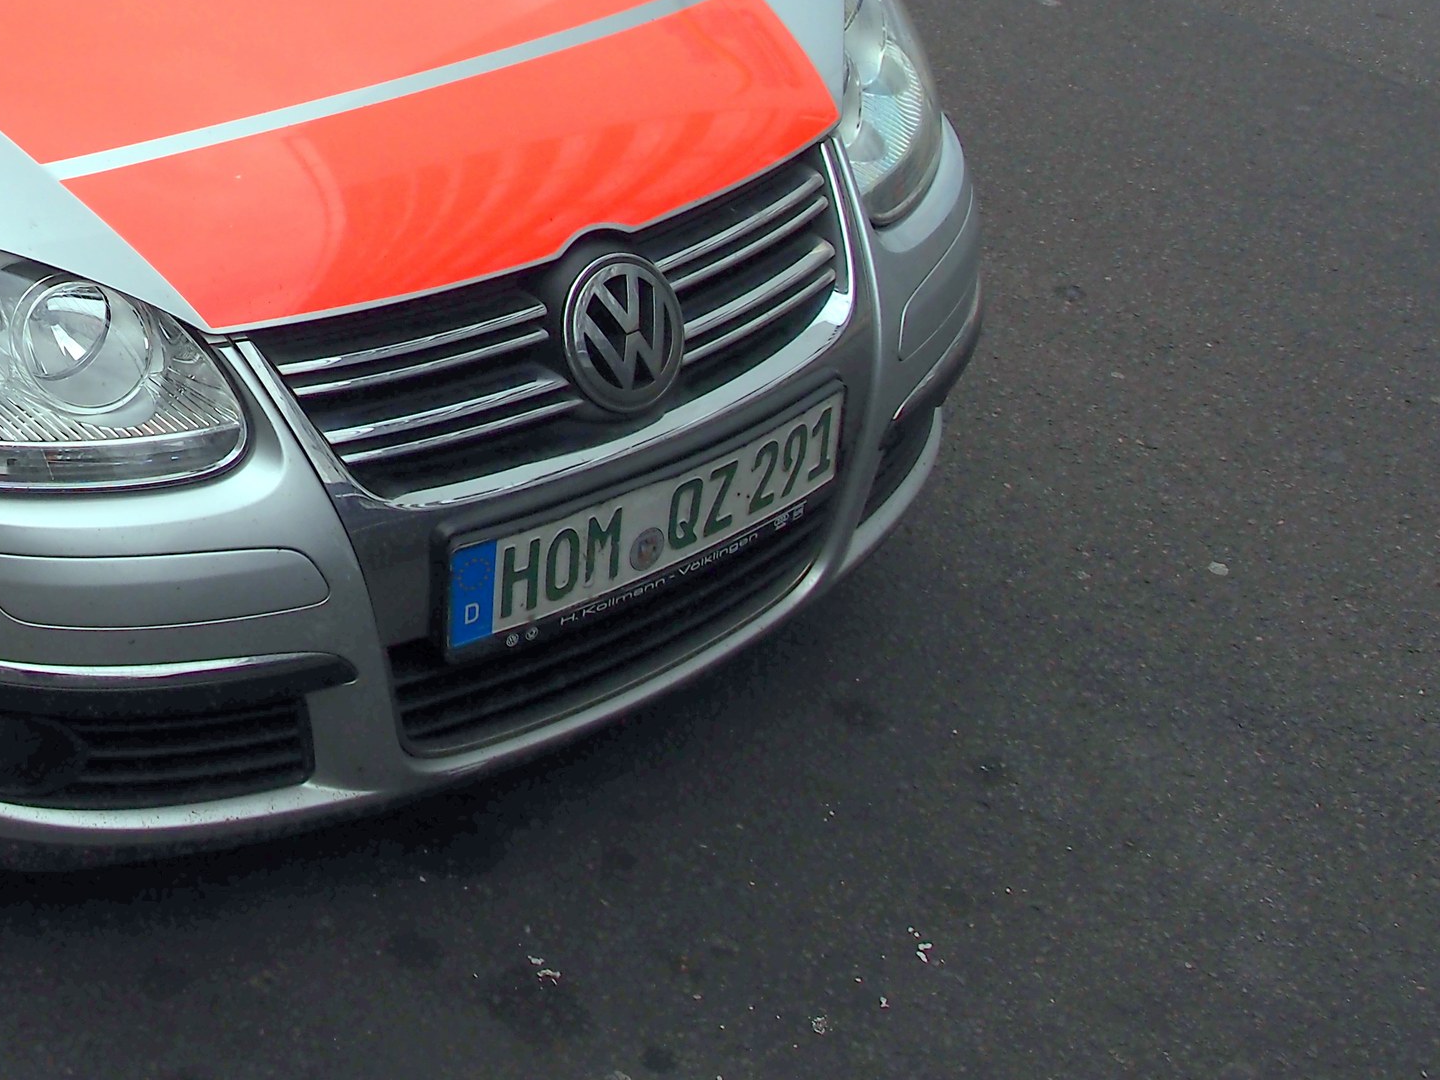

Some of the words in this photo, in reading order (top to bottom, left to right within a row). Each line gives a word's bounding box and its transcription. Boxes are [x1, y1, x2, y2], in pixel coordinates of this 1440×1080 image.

[500, 506, 623, 618] HOM
[668, 460, 739, 550] QZ
[748, 407, 832, 516] 291
[464, 602, 480, 625] D
[560, 611, 578, 626] H.
[582, 576, 667, 617] Kollmann
[678, 531, 758, 576] Völklingen
